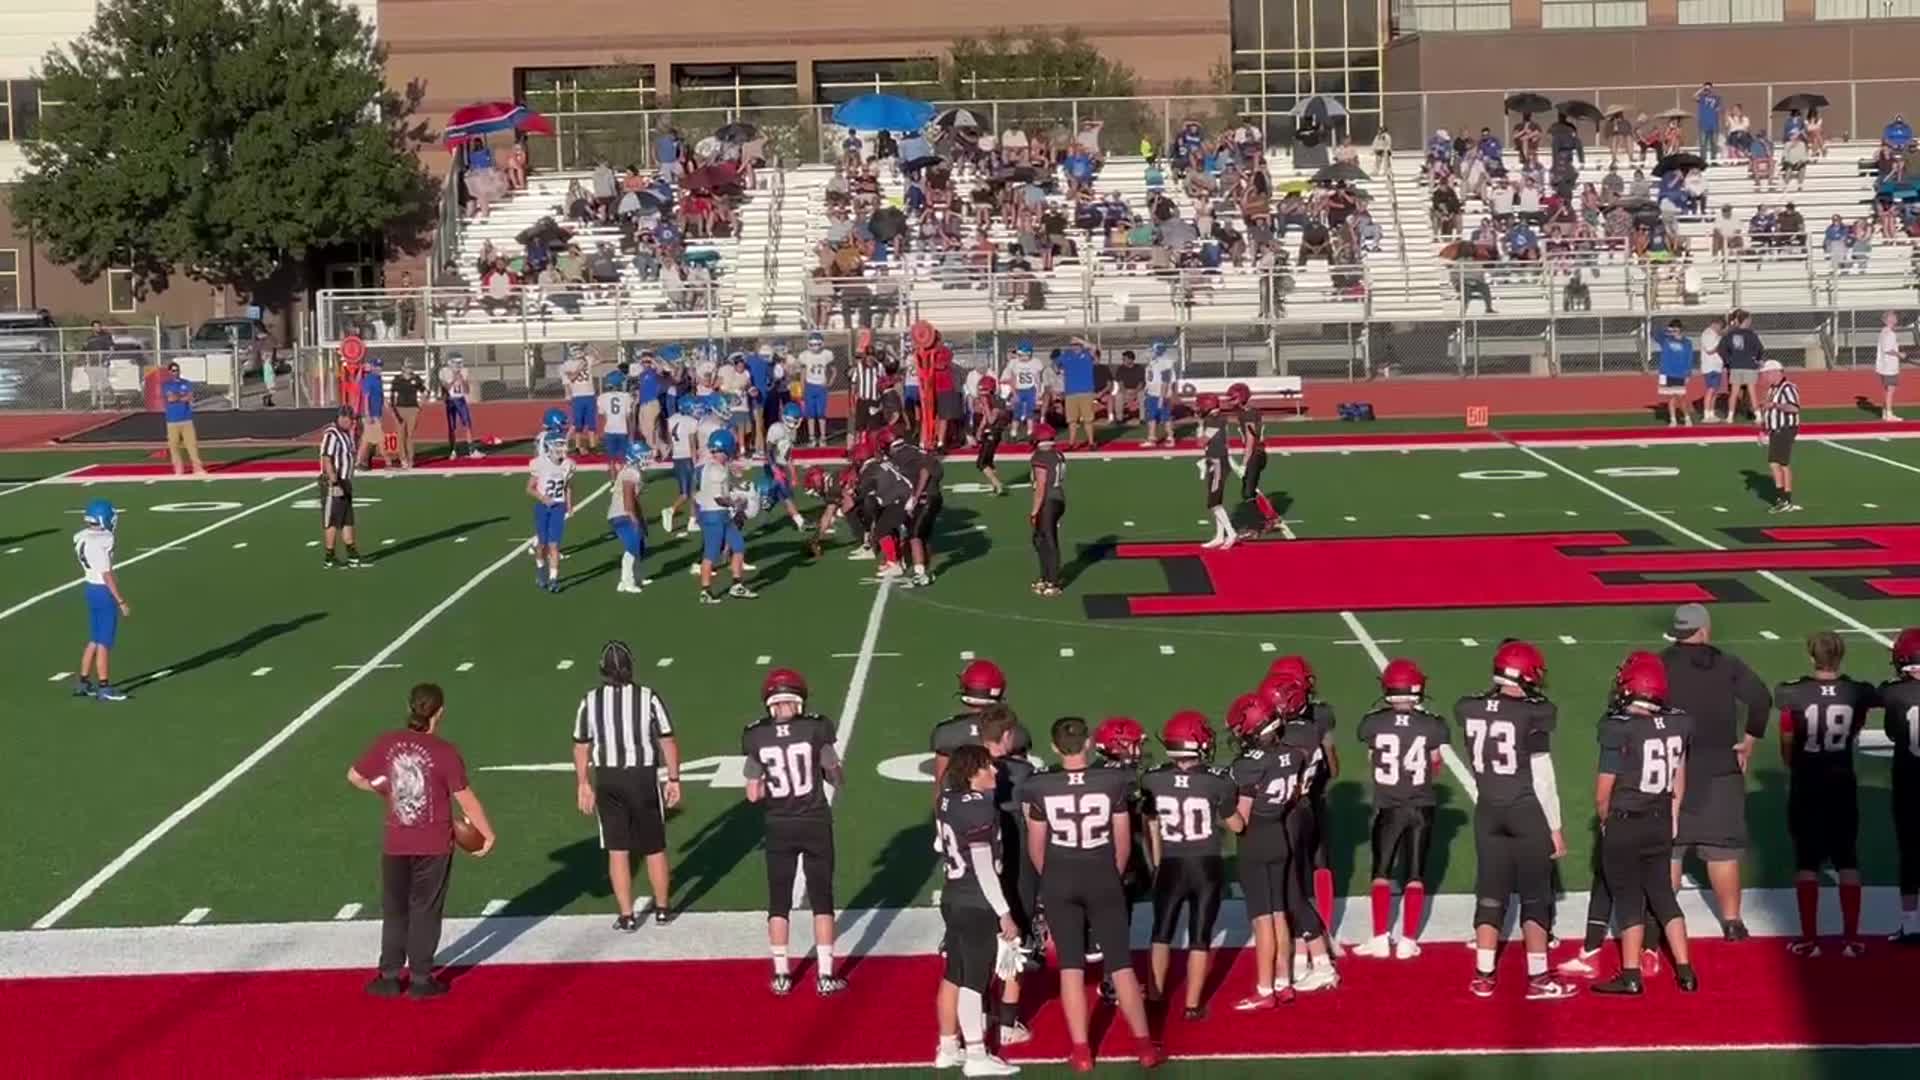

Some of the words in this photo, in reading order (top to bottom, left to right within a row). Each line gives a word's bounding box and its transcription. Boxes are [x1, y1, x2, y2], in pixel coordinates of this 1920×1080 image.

[610, 397, 620, 415] 6
[545, 480, 564, 498] 22
[1821, 685, 1836, 697] H
[1486, 700, 1499, 712] H
[1395, 714, 1410, 727] H
[1654, 717, 1666, 729] H
[1803, 704, 1853, 752] 18
[776, 724, 790, 737] H
[1465, 719, 1518, 775] 73
[1278, 753, 1291, 768] H
[1374, 734, 1427, 786] 34
[759, 742, 813, 797] 30
[1067, 772, 1085, 785] H
[1174, 775, 1189, 788] H
[1044, 794, 1110, 849] 52
[1155, 796, 1213, 842] 20
